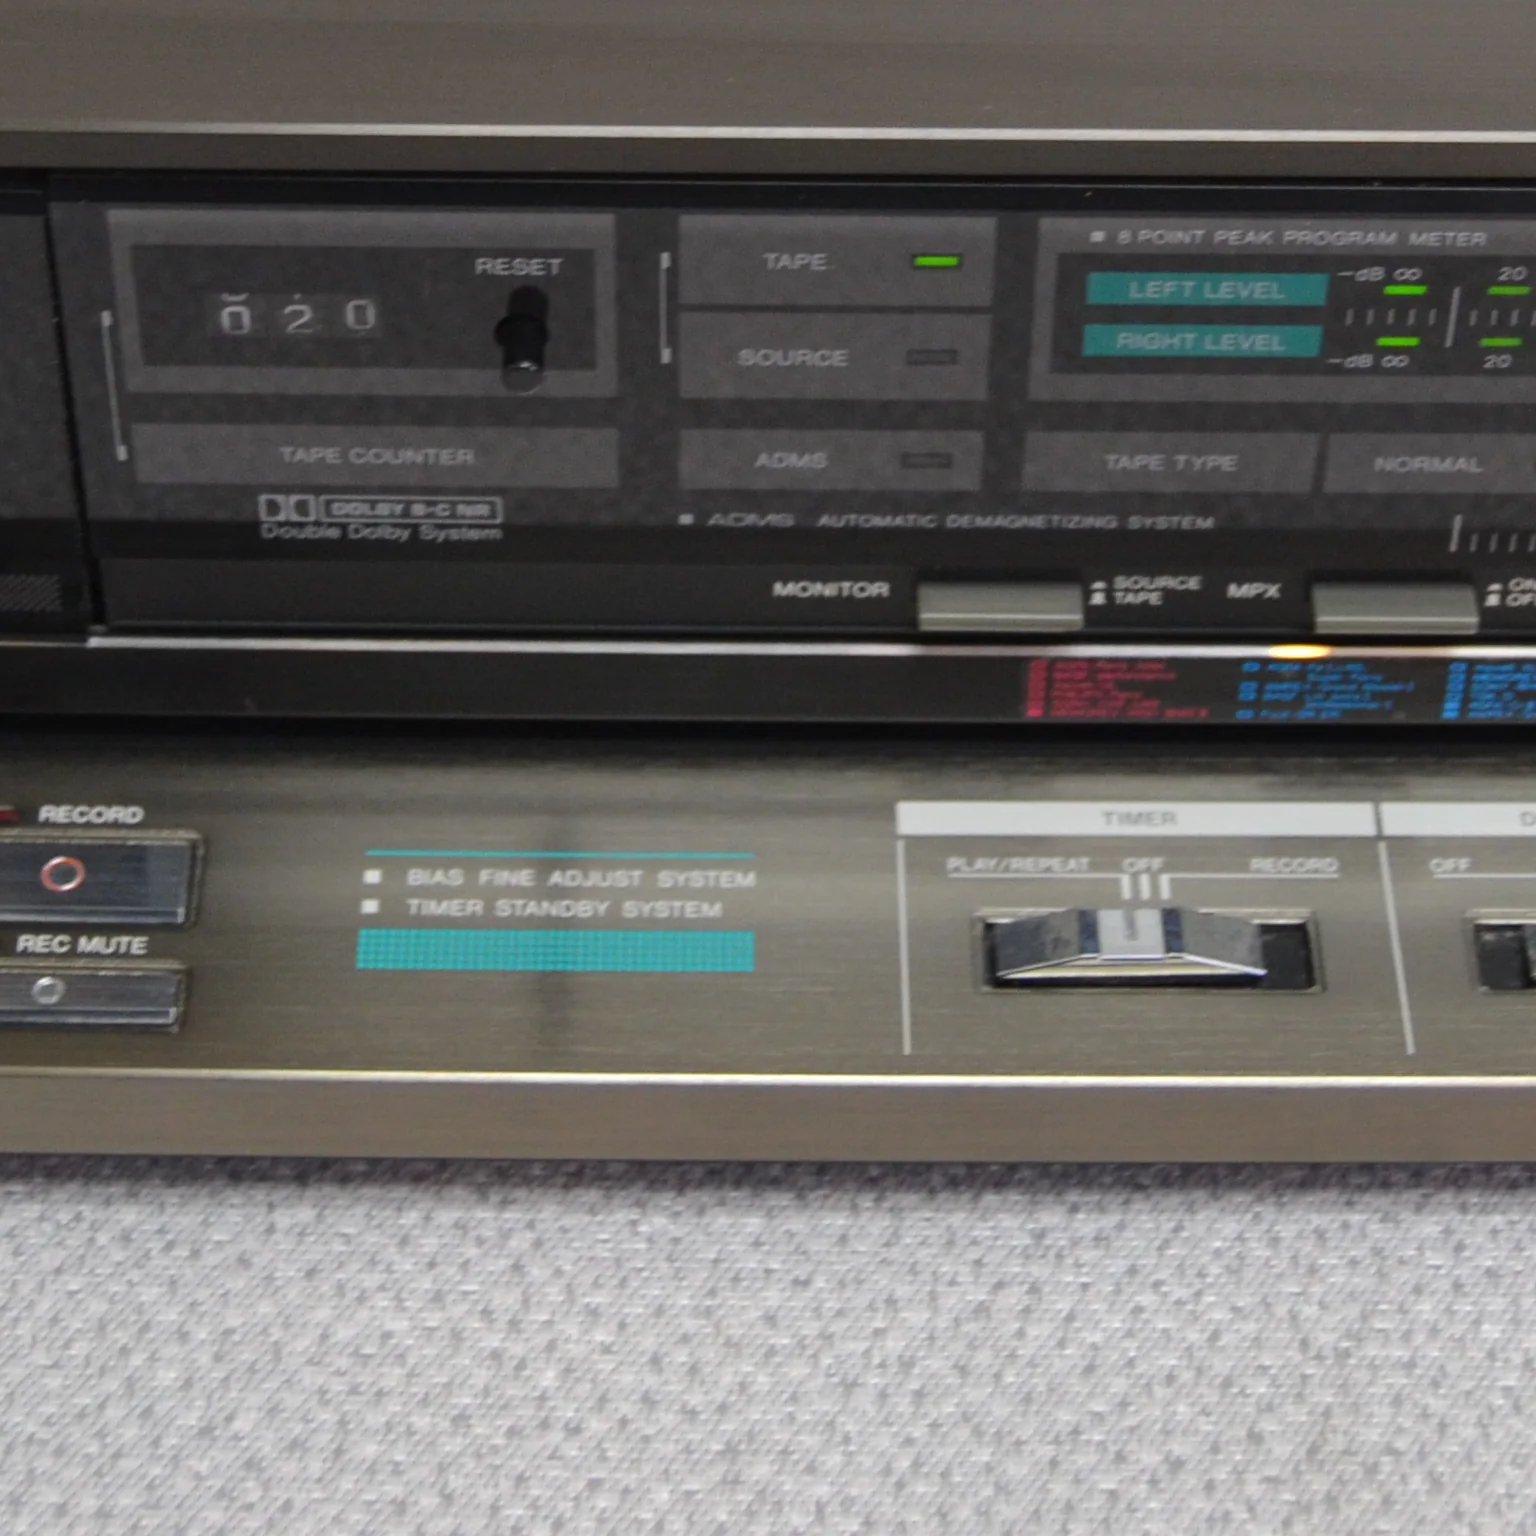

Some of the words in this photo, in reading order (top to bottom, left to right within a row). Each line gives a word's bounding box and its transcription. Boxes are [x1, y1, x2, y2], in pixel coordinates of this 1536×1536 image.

[1137, 228, 1207, 245] POINT
[1213, 229, 1276, 247] PEAK
[1282, 230, 1400, 248] PROGRAM
[1408, 230, 1490, 249] METER
[474, 257, 566, 277] RESET
[761, 252, 831, 272] TAPE
[1499, 267, 1530, 282] 20
[1128, 280, 1197, 301] LEFT
[1203, 281, 1287, 302] LEVEL
[1115, 331, 1197, 352] RIGHT
[1202, 332, 1287, 353] LEVEL
[735, 348, 851, 368] SOURCE
[1484, 354, 1514, 370] 20
[278, 445, 343, 464] TAPE
[347, 447, 476, 467] COUNTER
[1104, 453, 1167, 472] TAPE
[1174, 453, 1239, 473] TYPE
[1373, 454, 1484, 476] NORMAL
[816, 513, 937, 529] AUTOMATIC
[1126, 515, 1216, 532] SYSTEM
[261, 524, 343, 540] Double
[347, 524, 413, 543] Dolby
[418, 525, 506, 543] System
[772, 580, 893, 600] MONITOR
[1112, 575, 1204, 592] SOURCE
[1226, 581, 1282, 602] MPX
[1113, 590, 1165, 607] TAPE
[35, 804, 146, 827] RECORD
[1101, 809, 1179, 827] TIMER
[946, 855, 1092, 873] PLAY/REPEAT
[1121, 856, 1166, 873] OFF
[1248, 856, 1341, 874] RECORD
[1428, 856, 1474, 874] OFF
[405, 868, 465, 887] BIAS
[478, 868, 537, 887] FINE
[546, 868, 644, 888] ADJUST
[655, 868, 758, 889] SYSTEM
[406, 898, 485, 917] TIMER
[493, 898, 609, 918] STANDBY
[620, 899, 723, 919] SYSTEM
[15, 933, 78, 955] REC
[81, 934, 150, 956] MUTE
